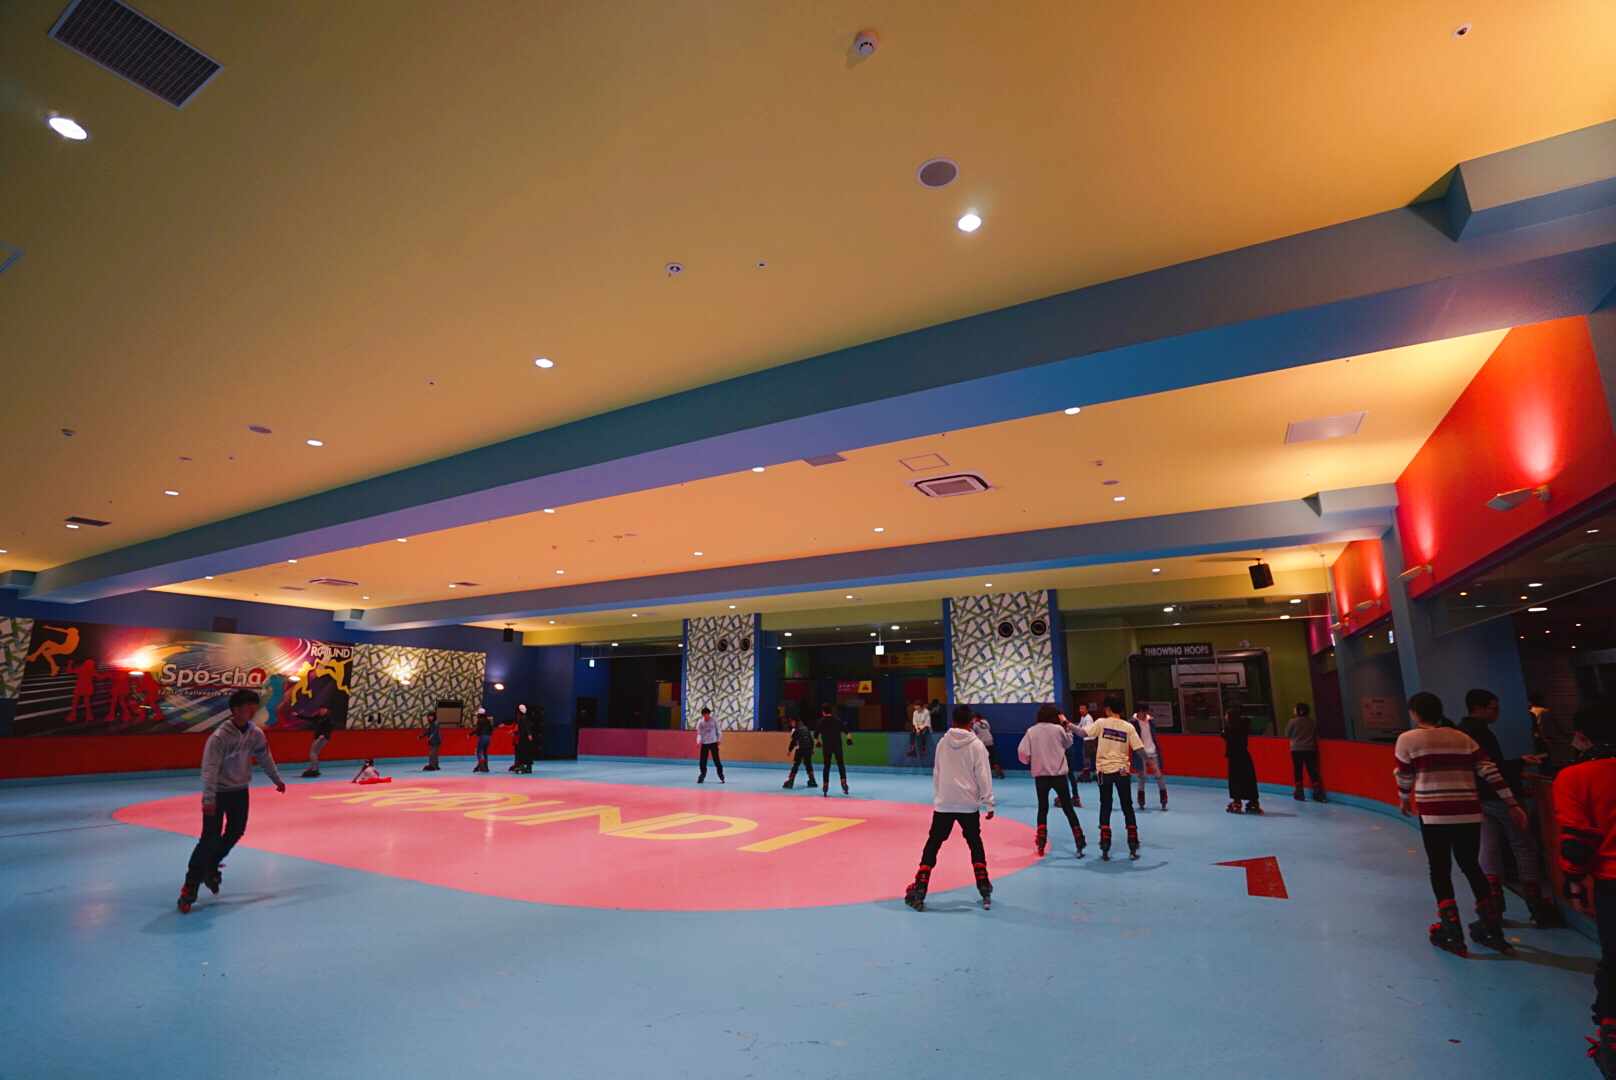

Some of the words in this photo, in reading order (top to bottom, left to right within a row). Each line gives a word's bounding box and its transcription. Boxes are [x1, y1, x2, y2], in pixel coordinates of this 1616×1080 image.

[1144, 647, 1182, 656] THROWING
[1184, 645, 1209, 655] HOOPS
[160, 663, 262, 687] Spo-cha
